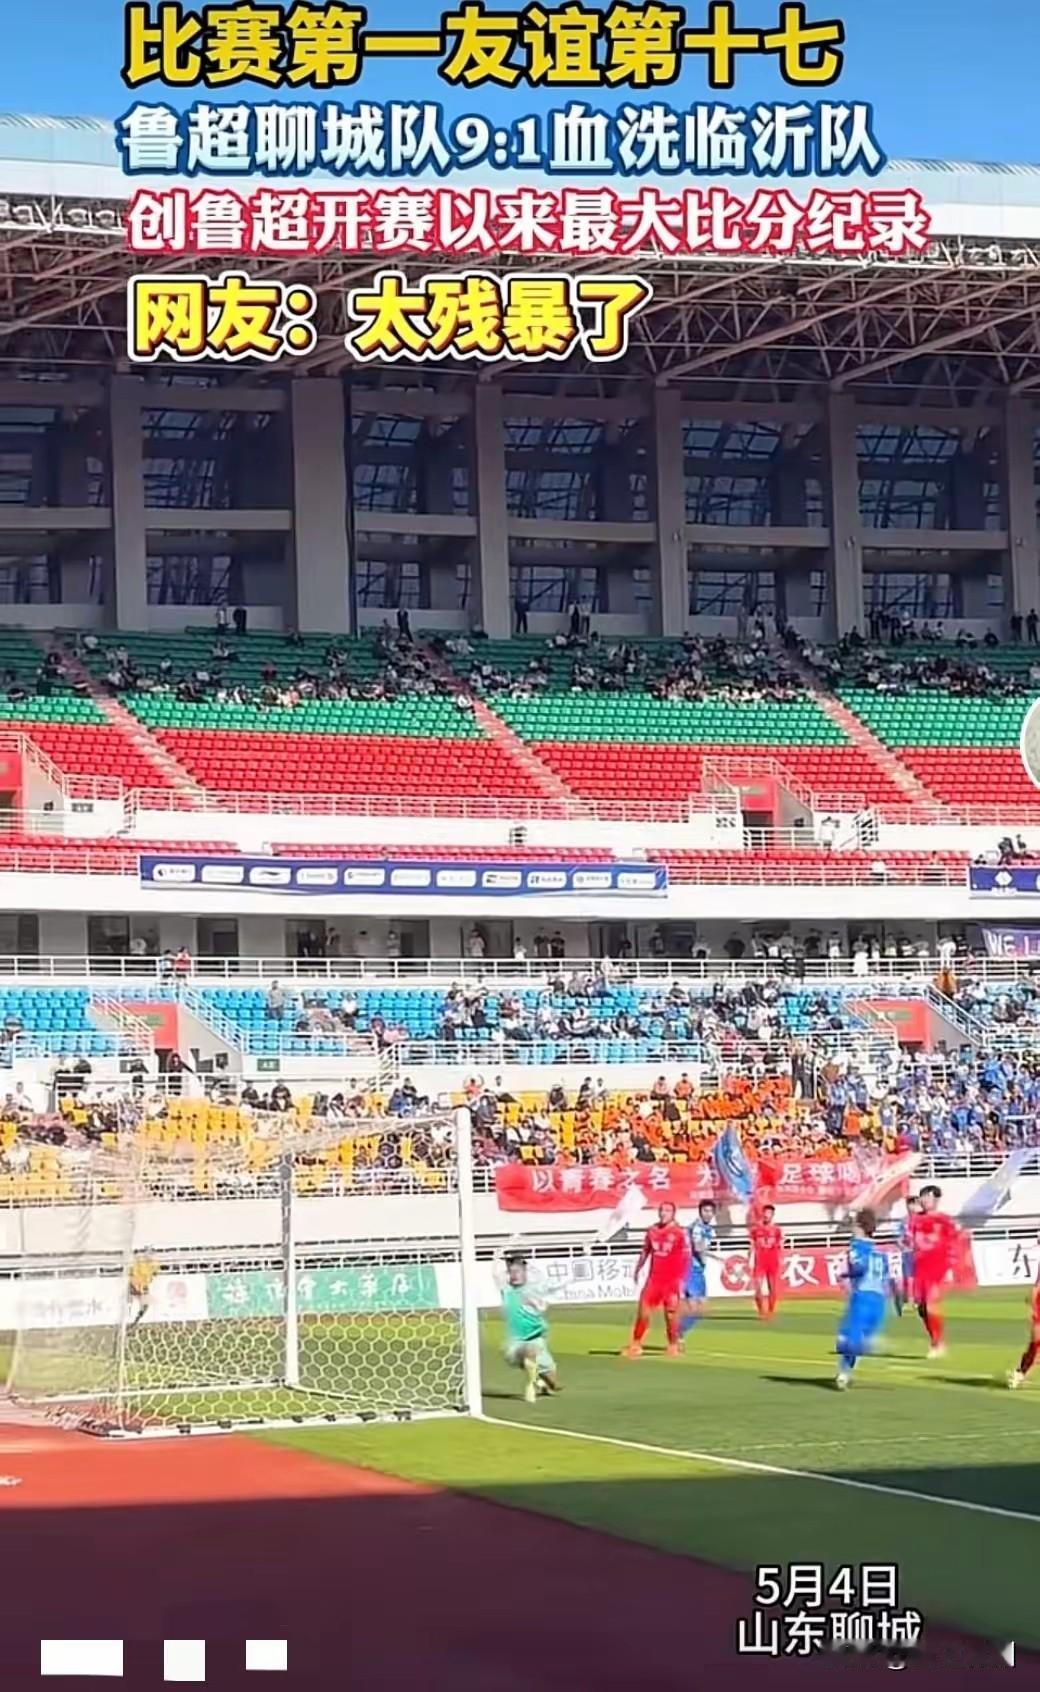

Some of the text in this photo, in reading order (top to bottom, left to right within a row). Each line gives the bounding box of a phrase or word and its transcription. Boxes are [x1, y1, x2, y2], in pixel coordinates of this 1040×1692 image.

[531, 1166, 671, 1193] 以青春之名
